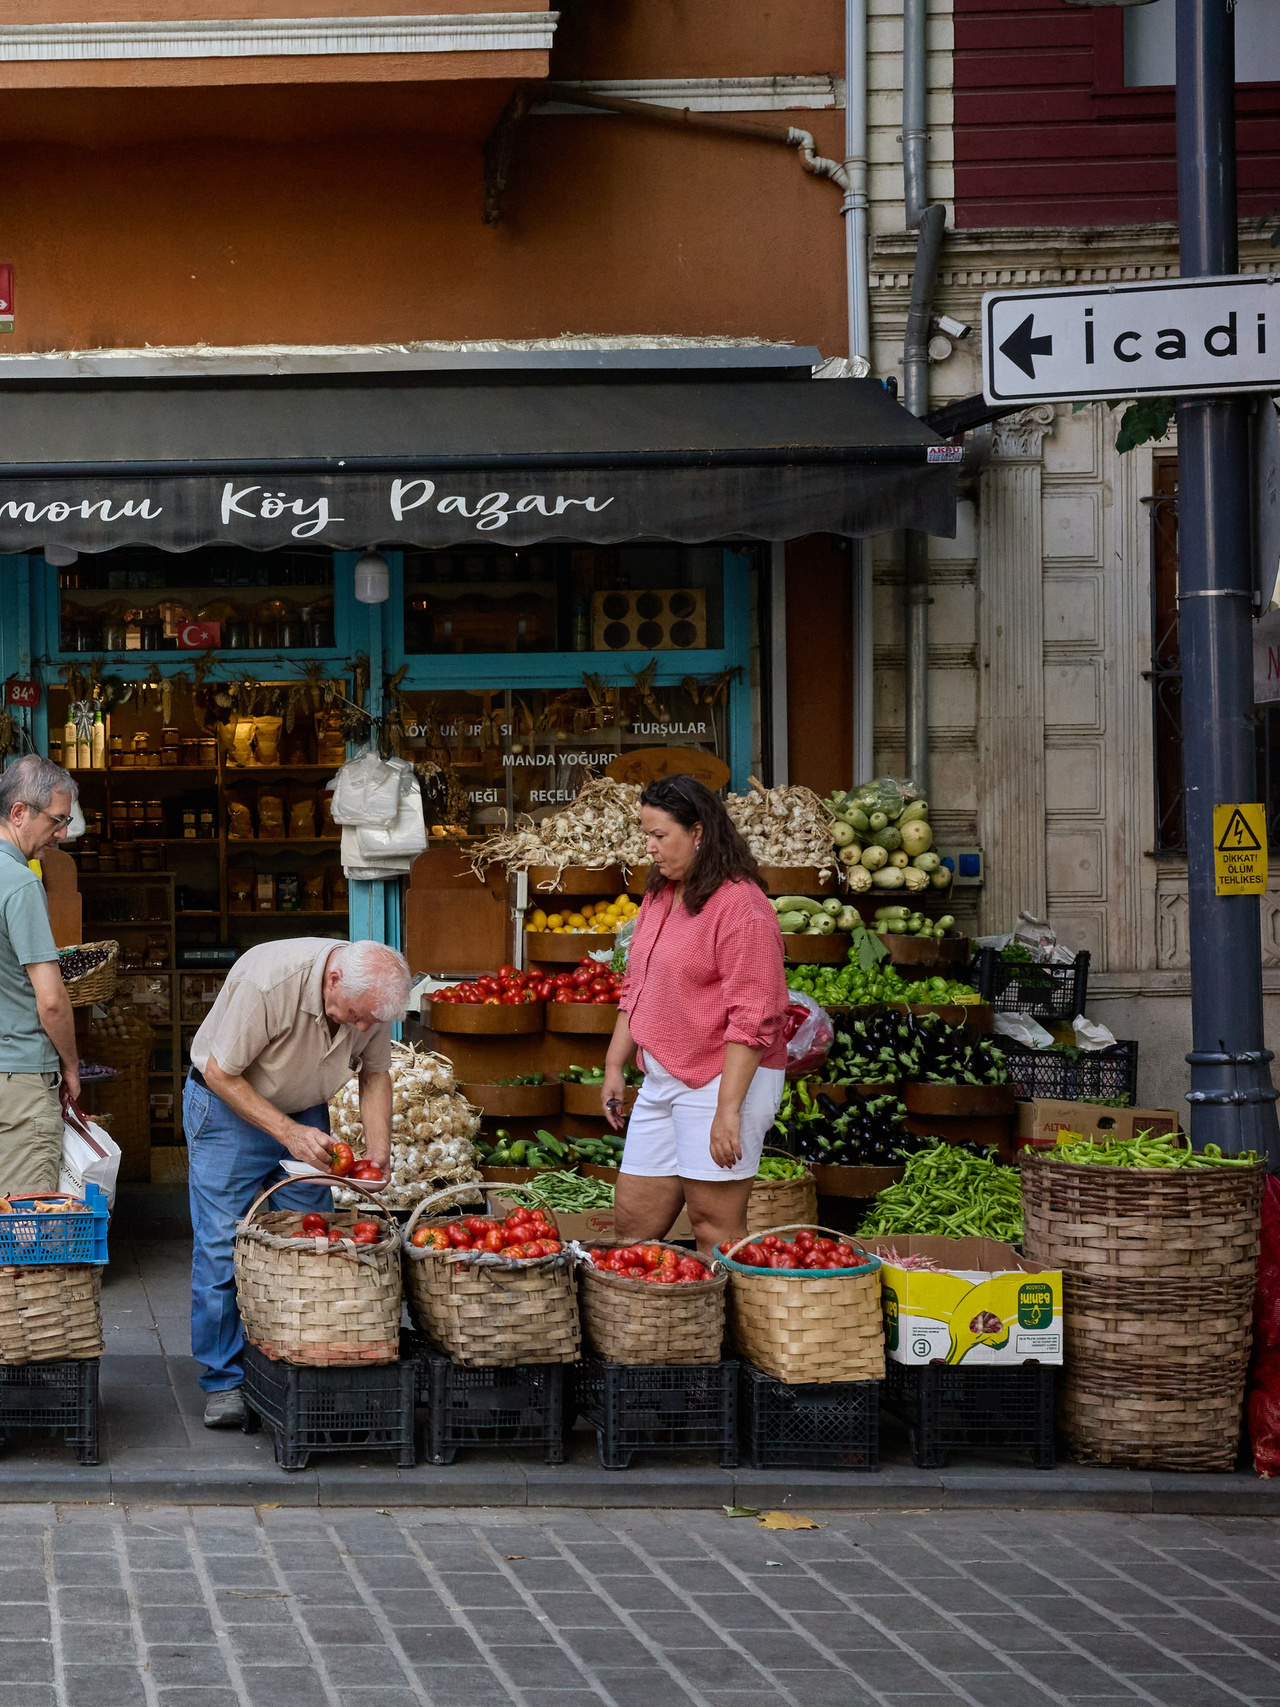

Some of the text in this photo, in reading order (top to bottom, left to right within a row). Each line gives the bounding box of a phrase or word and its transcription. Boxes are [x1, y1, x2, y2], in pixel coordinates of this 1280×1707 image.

[221, 482, 345, 538] Köy
[389, 478, 616, 532] Pazarı
[632, 722, 707, 738] TURŞULAR
[502, 751, 622, 767] MANDA YOĞURD
[1222, 852, 1258, 863] DİKKAT!
[1227, 863, 1254, 874] ÖLÜM
[1219, 872, 1264, 885] TEHLİKESİ
